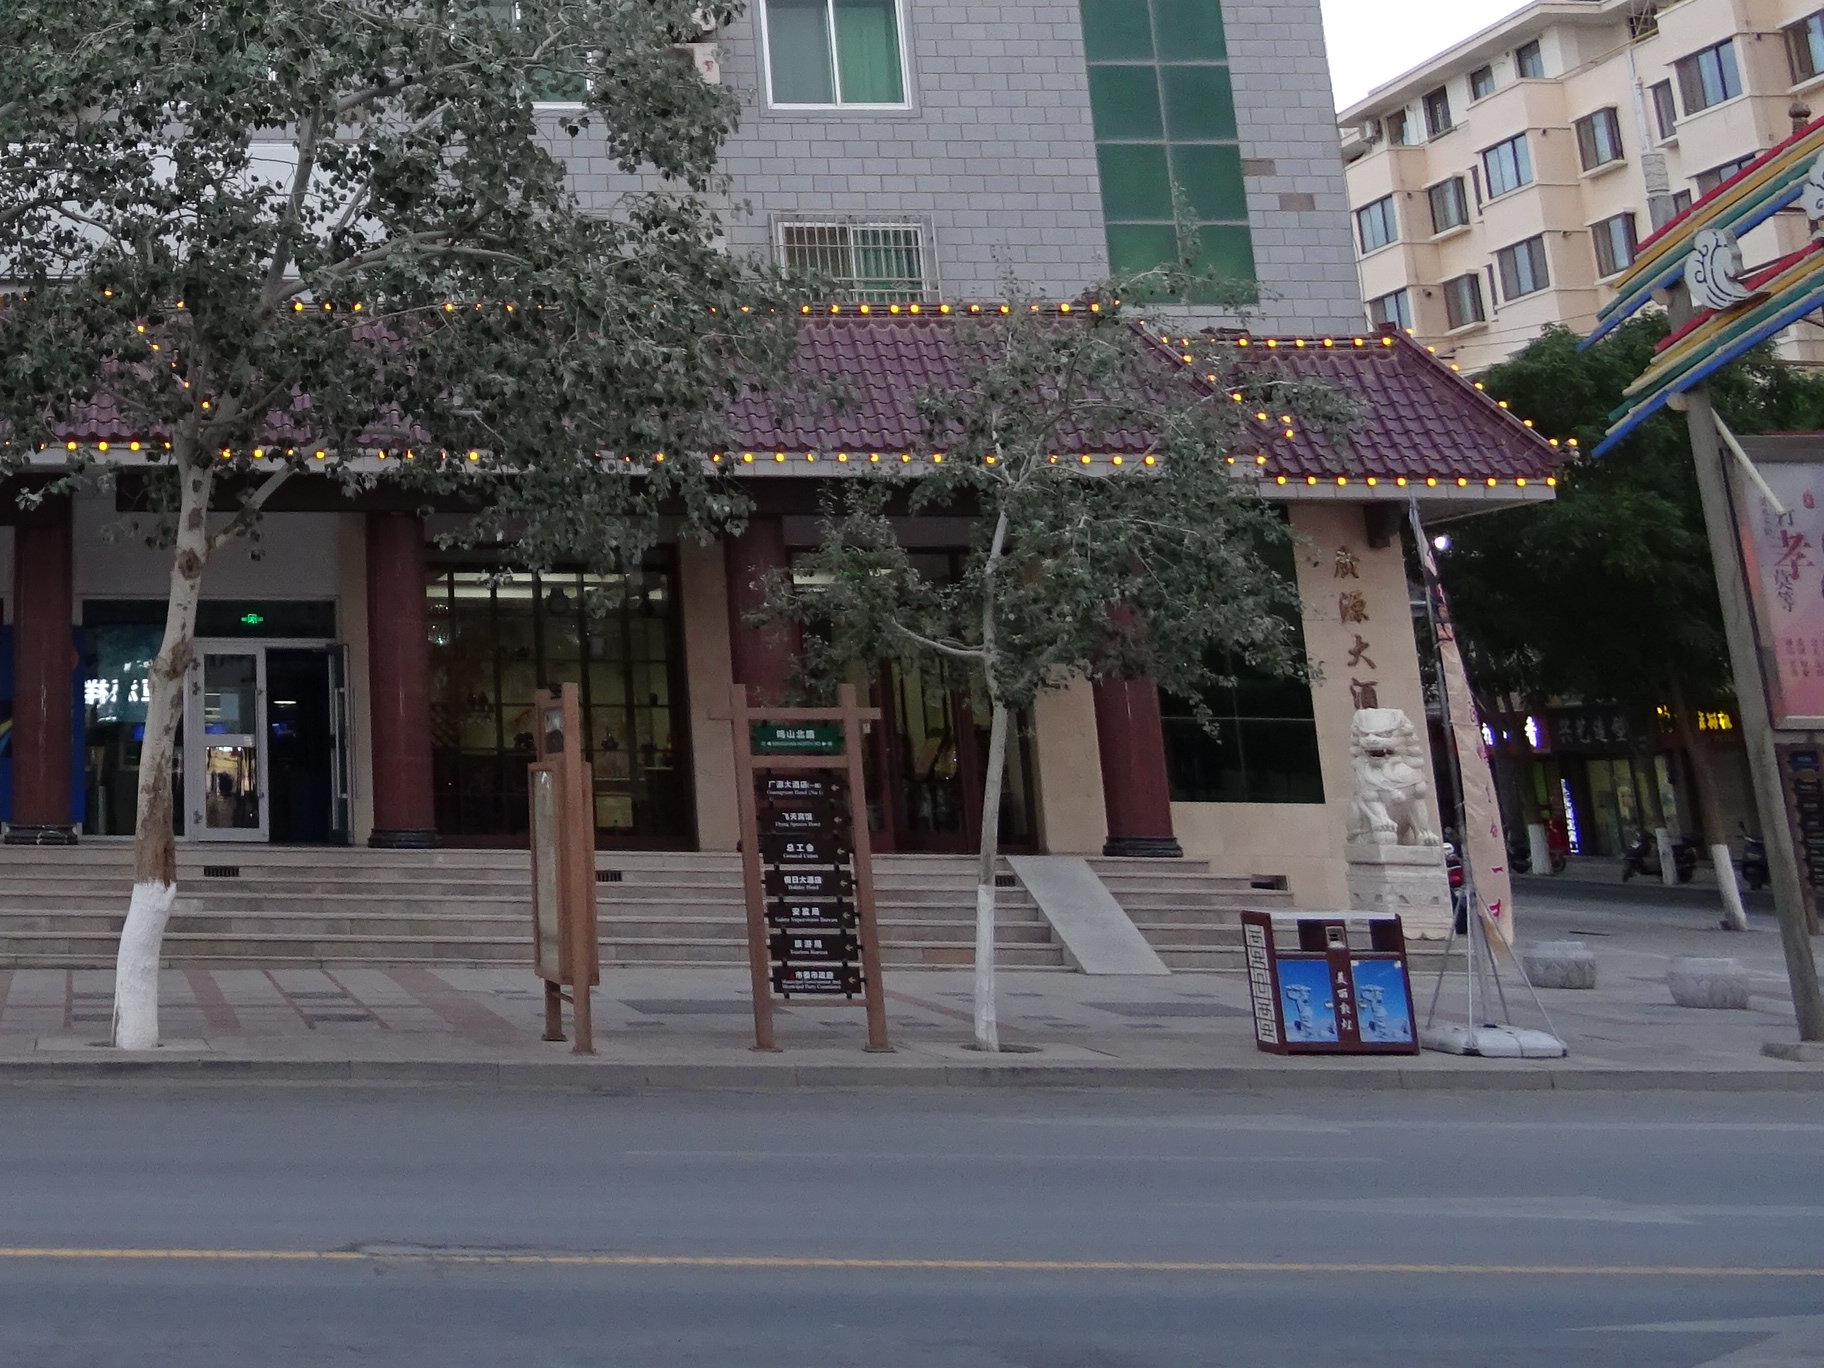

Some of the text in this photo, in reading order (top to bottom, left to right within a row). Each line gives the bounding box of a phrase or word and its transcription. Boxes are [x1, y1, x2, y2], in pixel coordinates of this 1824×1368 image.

[781, 812, 813, 821] 飞天宾馆
[786, 843, 814, 852] 总工会
[783, 875, 822, 884] 假日大酒店
